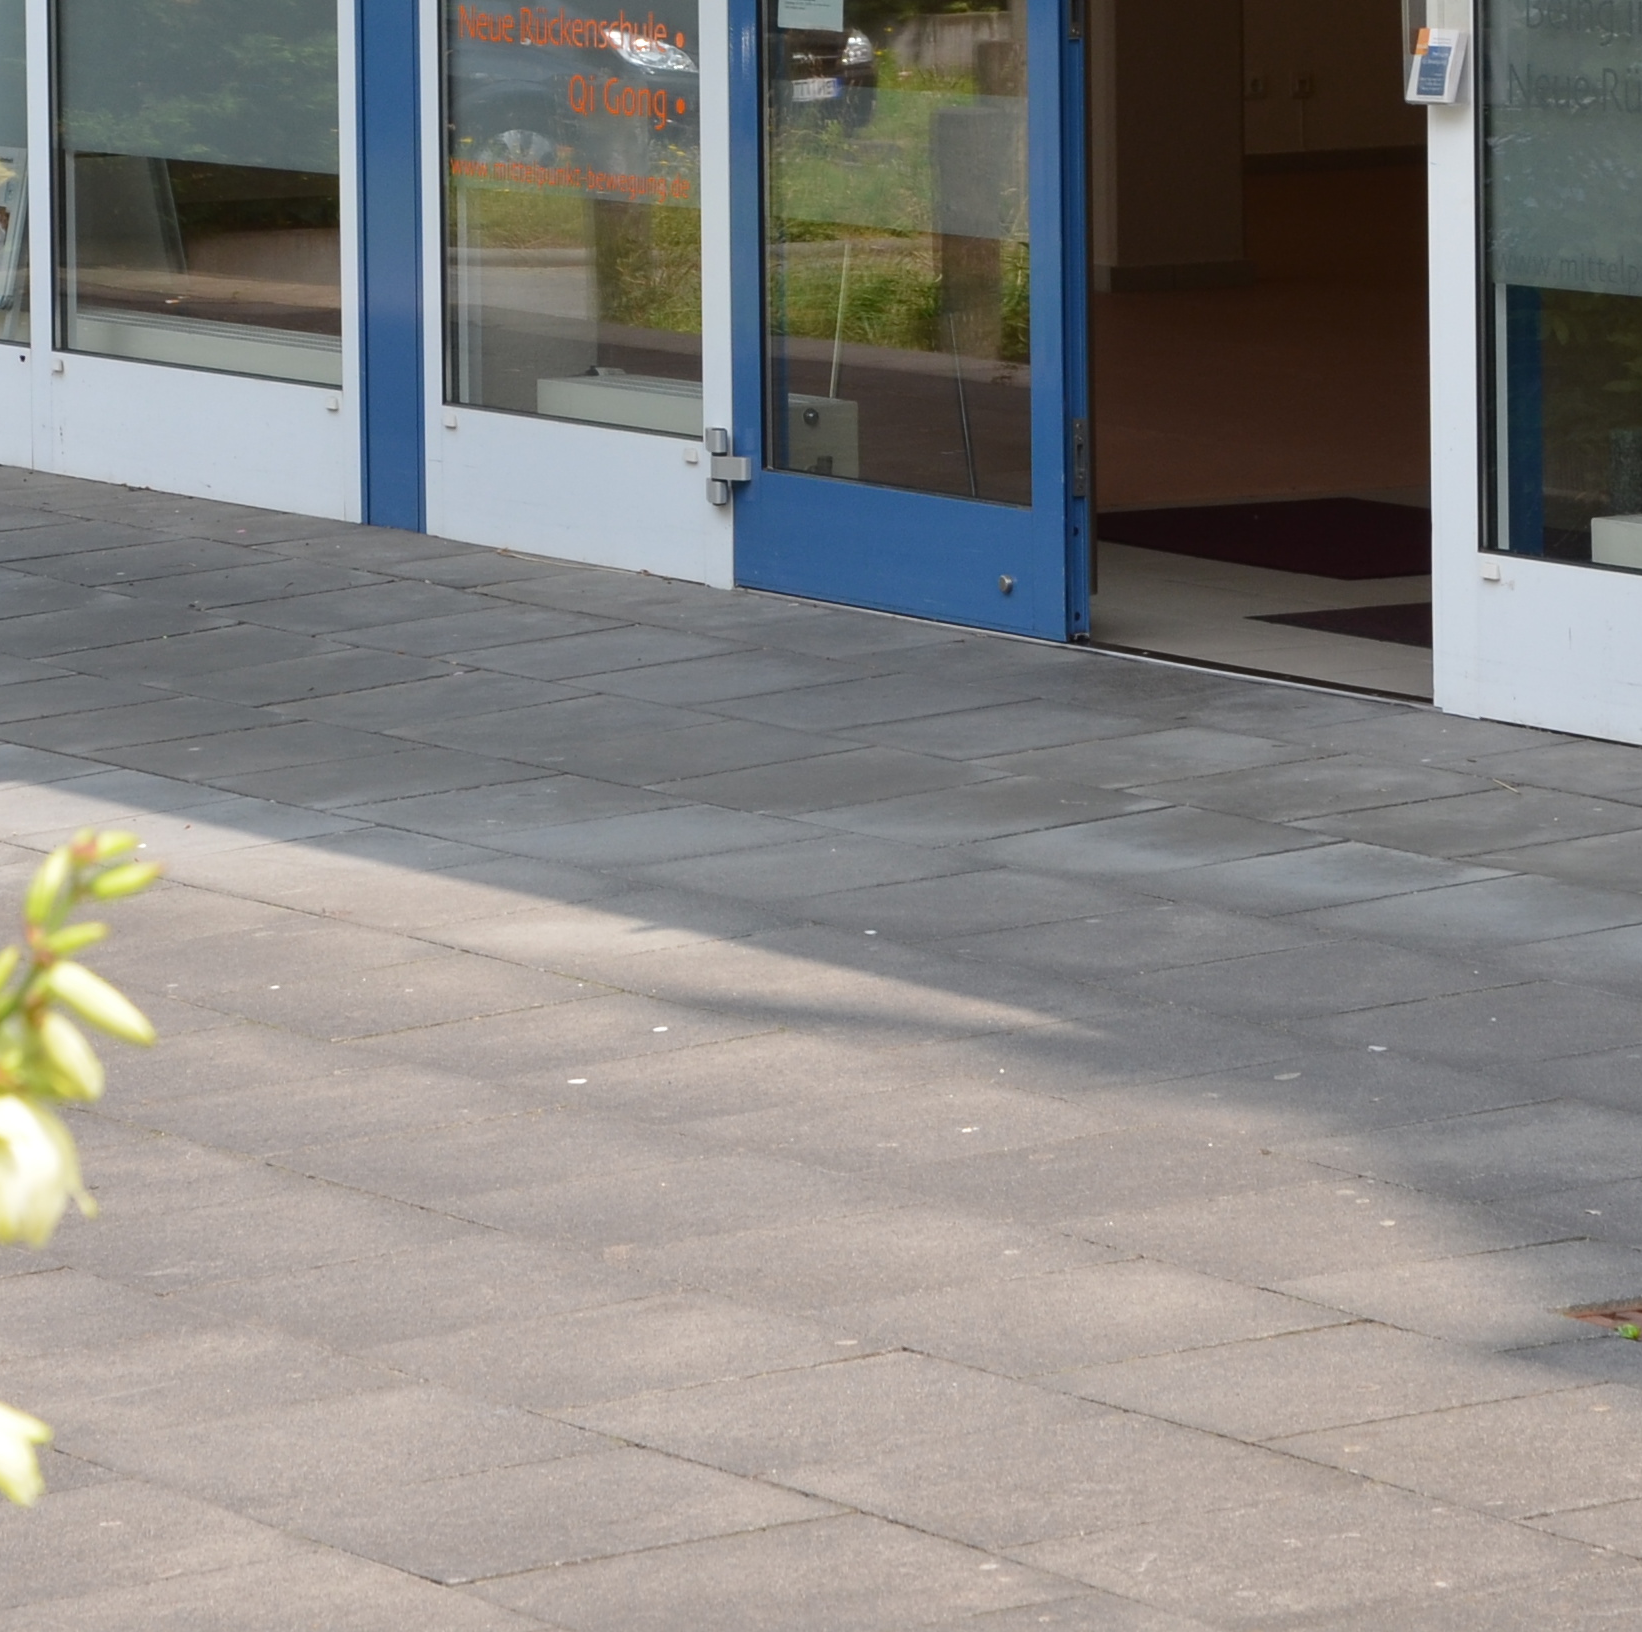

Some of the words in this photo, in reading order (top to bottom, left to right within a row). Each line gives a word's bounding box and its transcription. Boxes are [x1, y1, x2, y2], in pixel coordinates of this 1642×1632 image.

[458, 5, 515, 43] Neue
[519, 6, 668, 53] Rückenschule
[568, 74, 595, 117] Qi
[603, 77, 668, 131] Gong
[450, 158, 691, 204] www.mittelpunkt-bewegung.de
